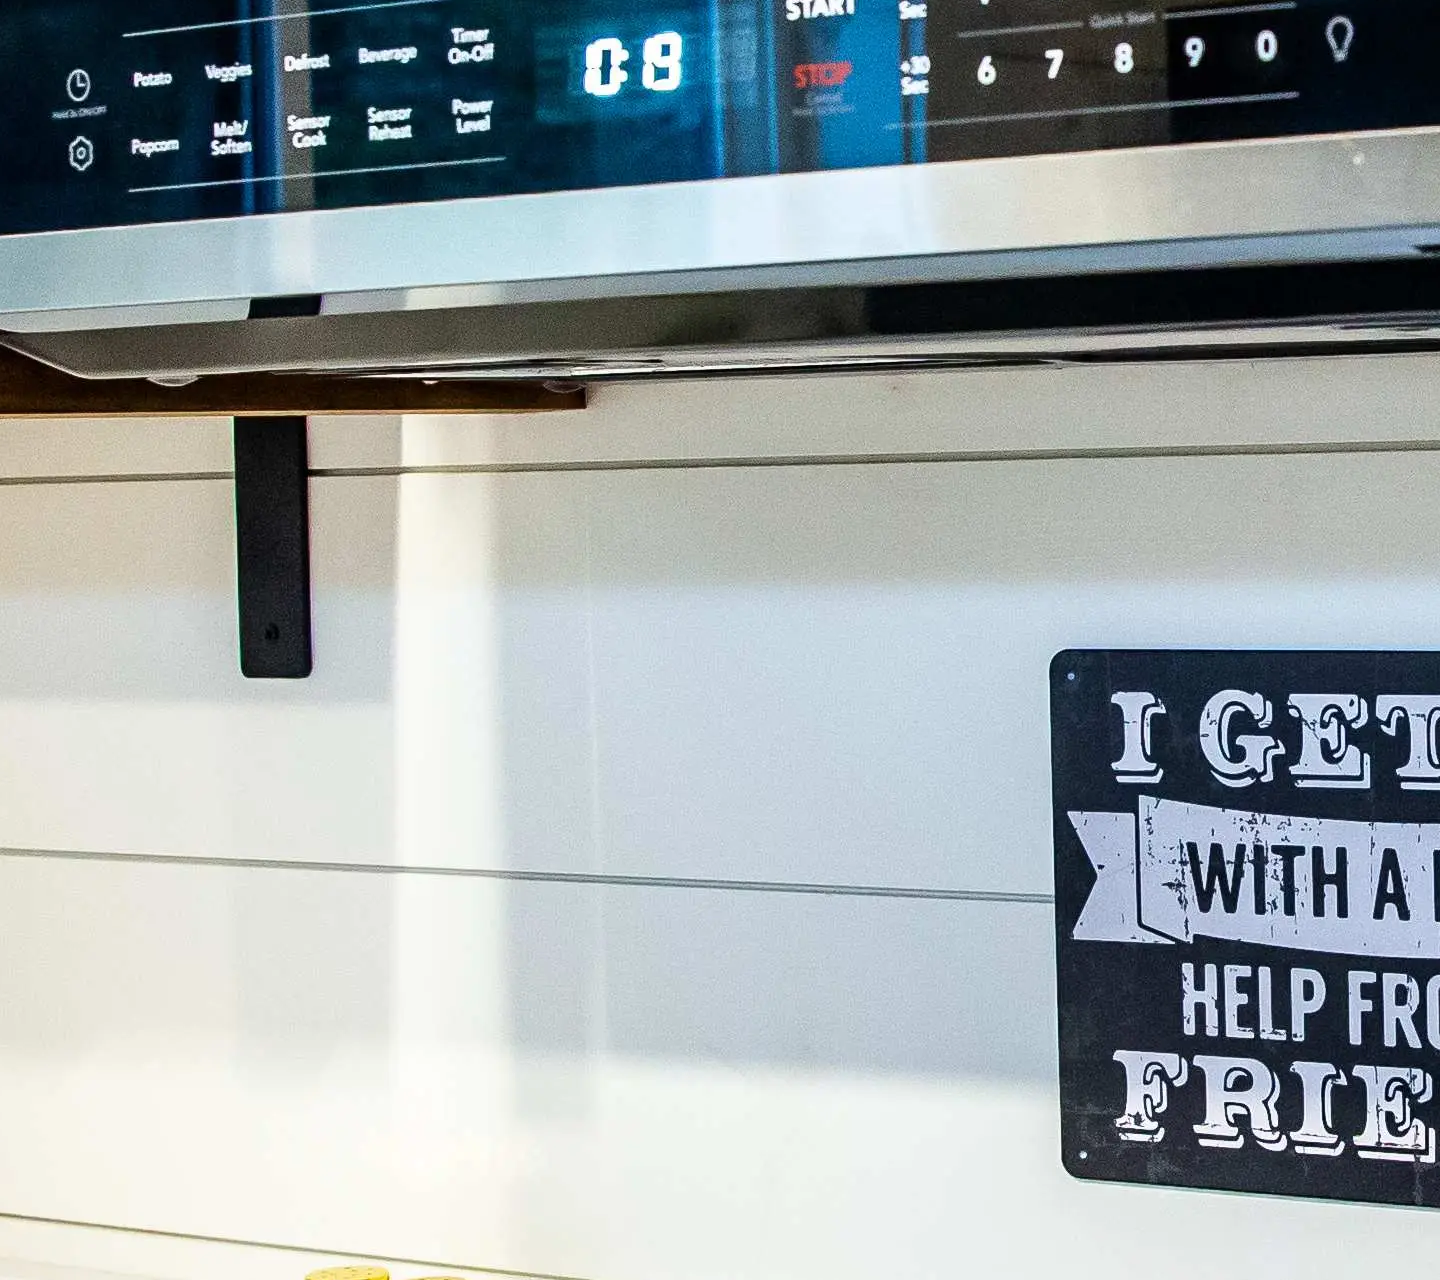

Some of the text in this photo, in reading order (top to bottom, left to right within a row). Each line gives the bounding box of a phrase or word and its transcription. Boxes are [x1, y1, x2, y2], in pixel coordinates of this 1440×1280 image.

[450, 27, 490, 44] Timer
[283, 52, 331, 72] Defrost
[357, 46, 418, 64] Beverage
[977, 29, 1278, 86] 6 7 8 9 0
[133, 71, 173, 88] Potato
[204, 62, 253, 83] Veggies
[793, 60, 853, 88] STOP
[367, 106, 413, 124] Sensor
[451, 98, 494, 116] Power
[286, 114, 332, 132] Sensor
[368, 124, 413, 141] Reheat
[456, 114, 491, 133] Level
[130, 138, 180, 158] Popcorn
[211, 138, 253, 156] Soften
[291, 130, 328, 149] Cook
[1111, 690, 1166, 785] I
[1184, 840, 1350, 920] WITH
[1372, 846, 1410, 922] A
[1181, 962, 1327, 1043] HELP
